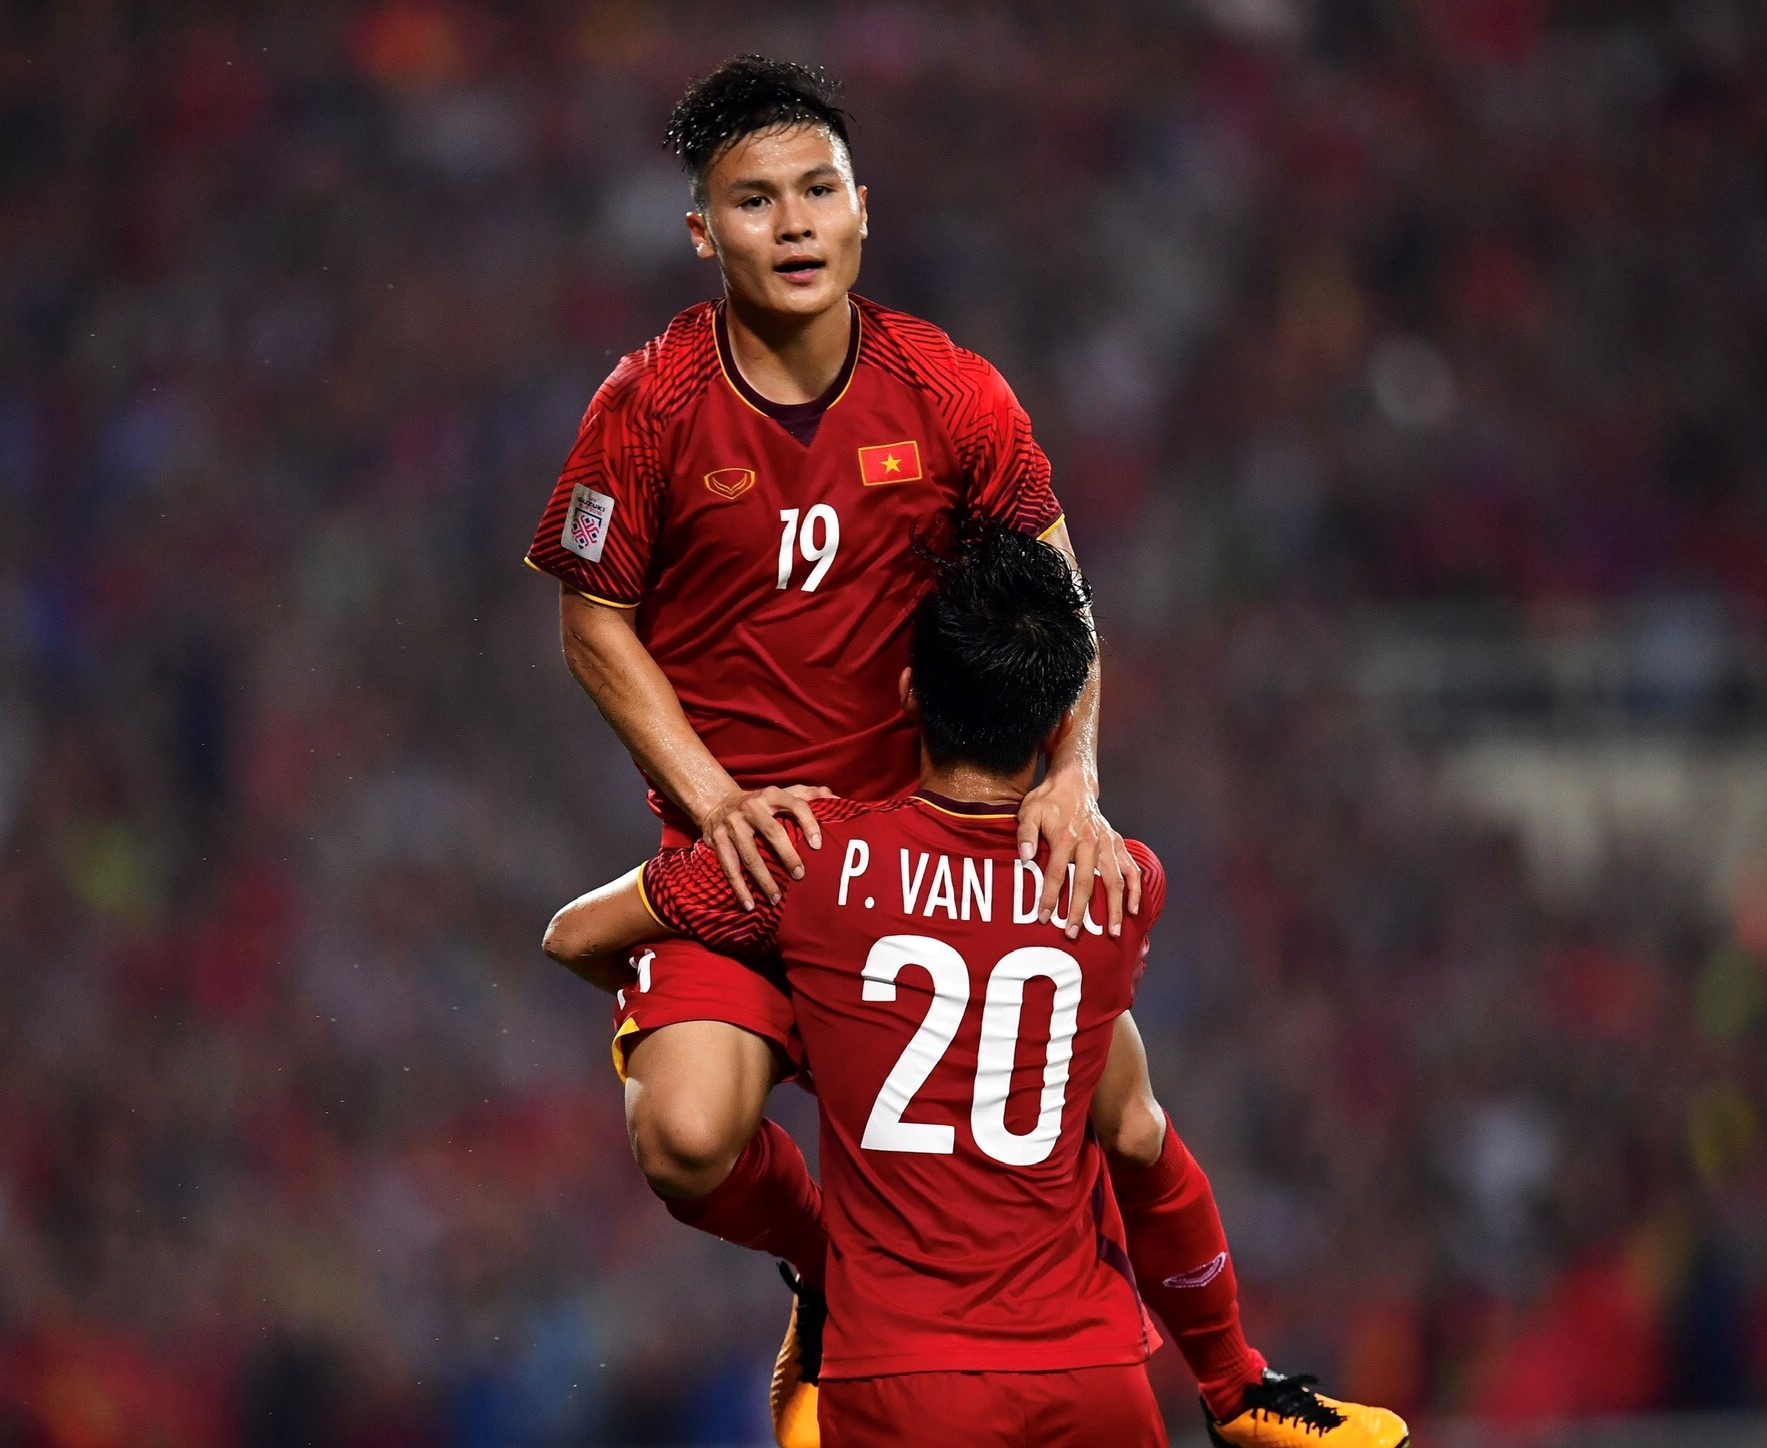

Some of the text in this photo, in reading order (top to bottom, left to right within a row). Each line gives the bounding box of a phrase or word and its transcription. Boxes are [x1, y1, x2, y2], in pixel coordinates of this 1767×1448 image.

[578, 497, 605, 512] SUZUKI
[776, 503, 840, 592] 19
[838, 839, 875, 909] P.
[900, 848, 993, 922] VAN
[860, 934, 1083, 1166] 20
